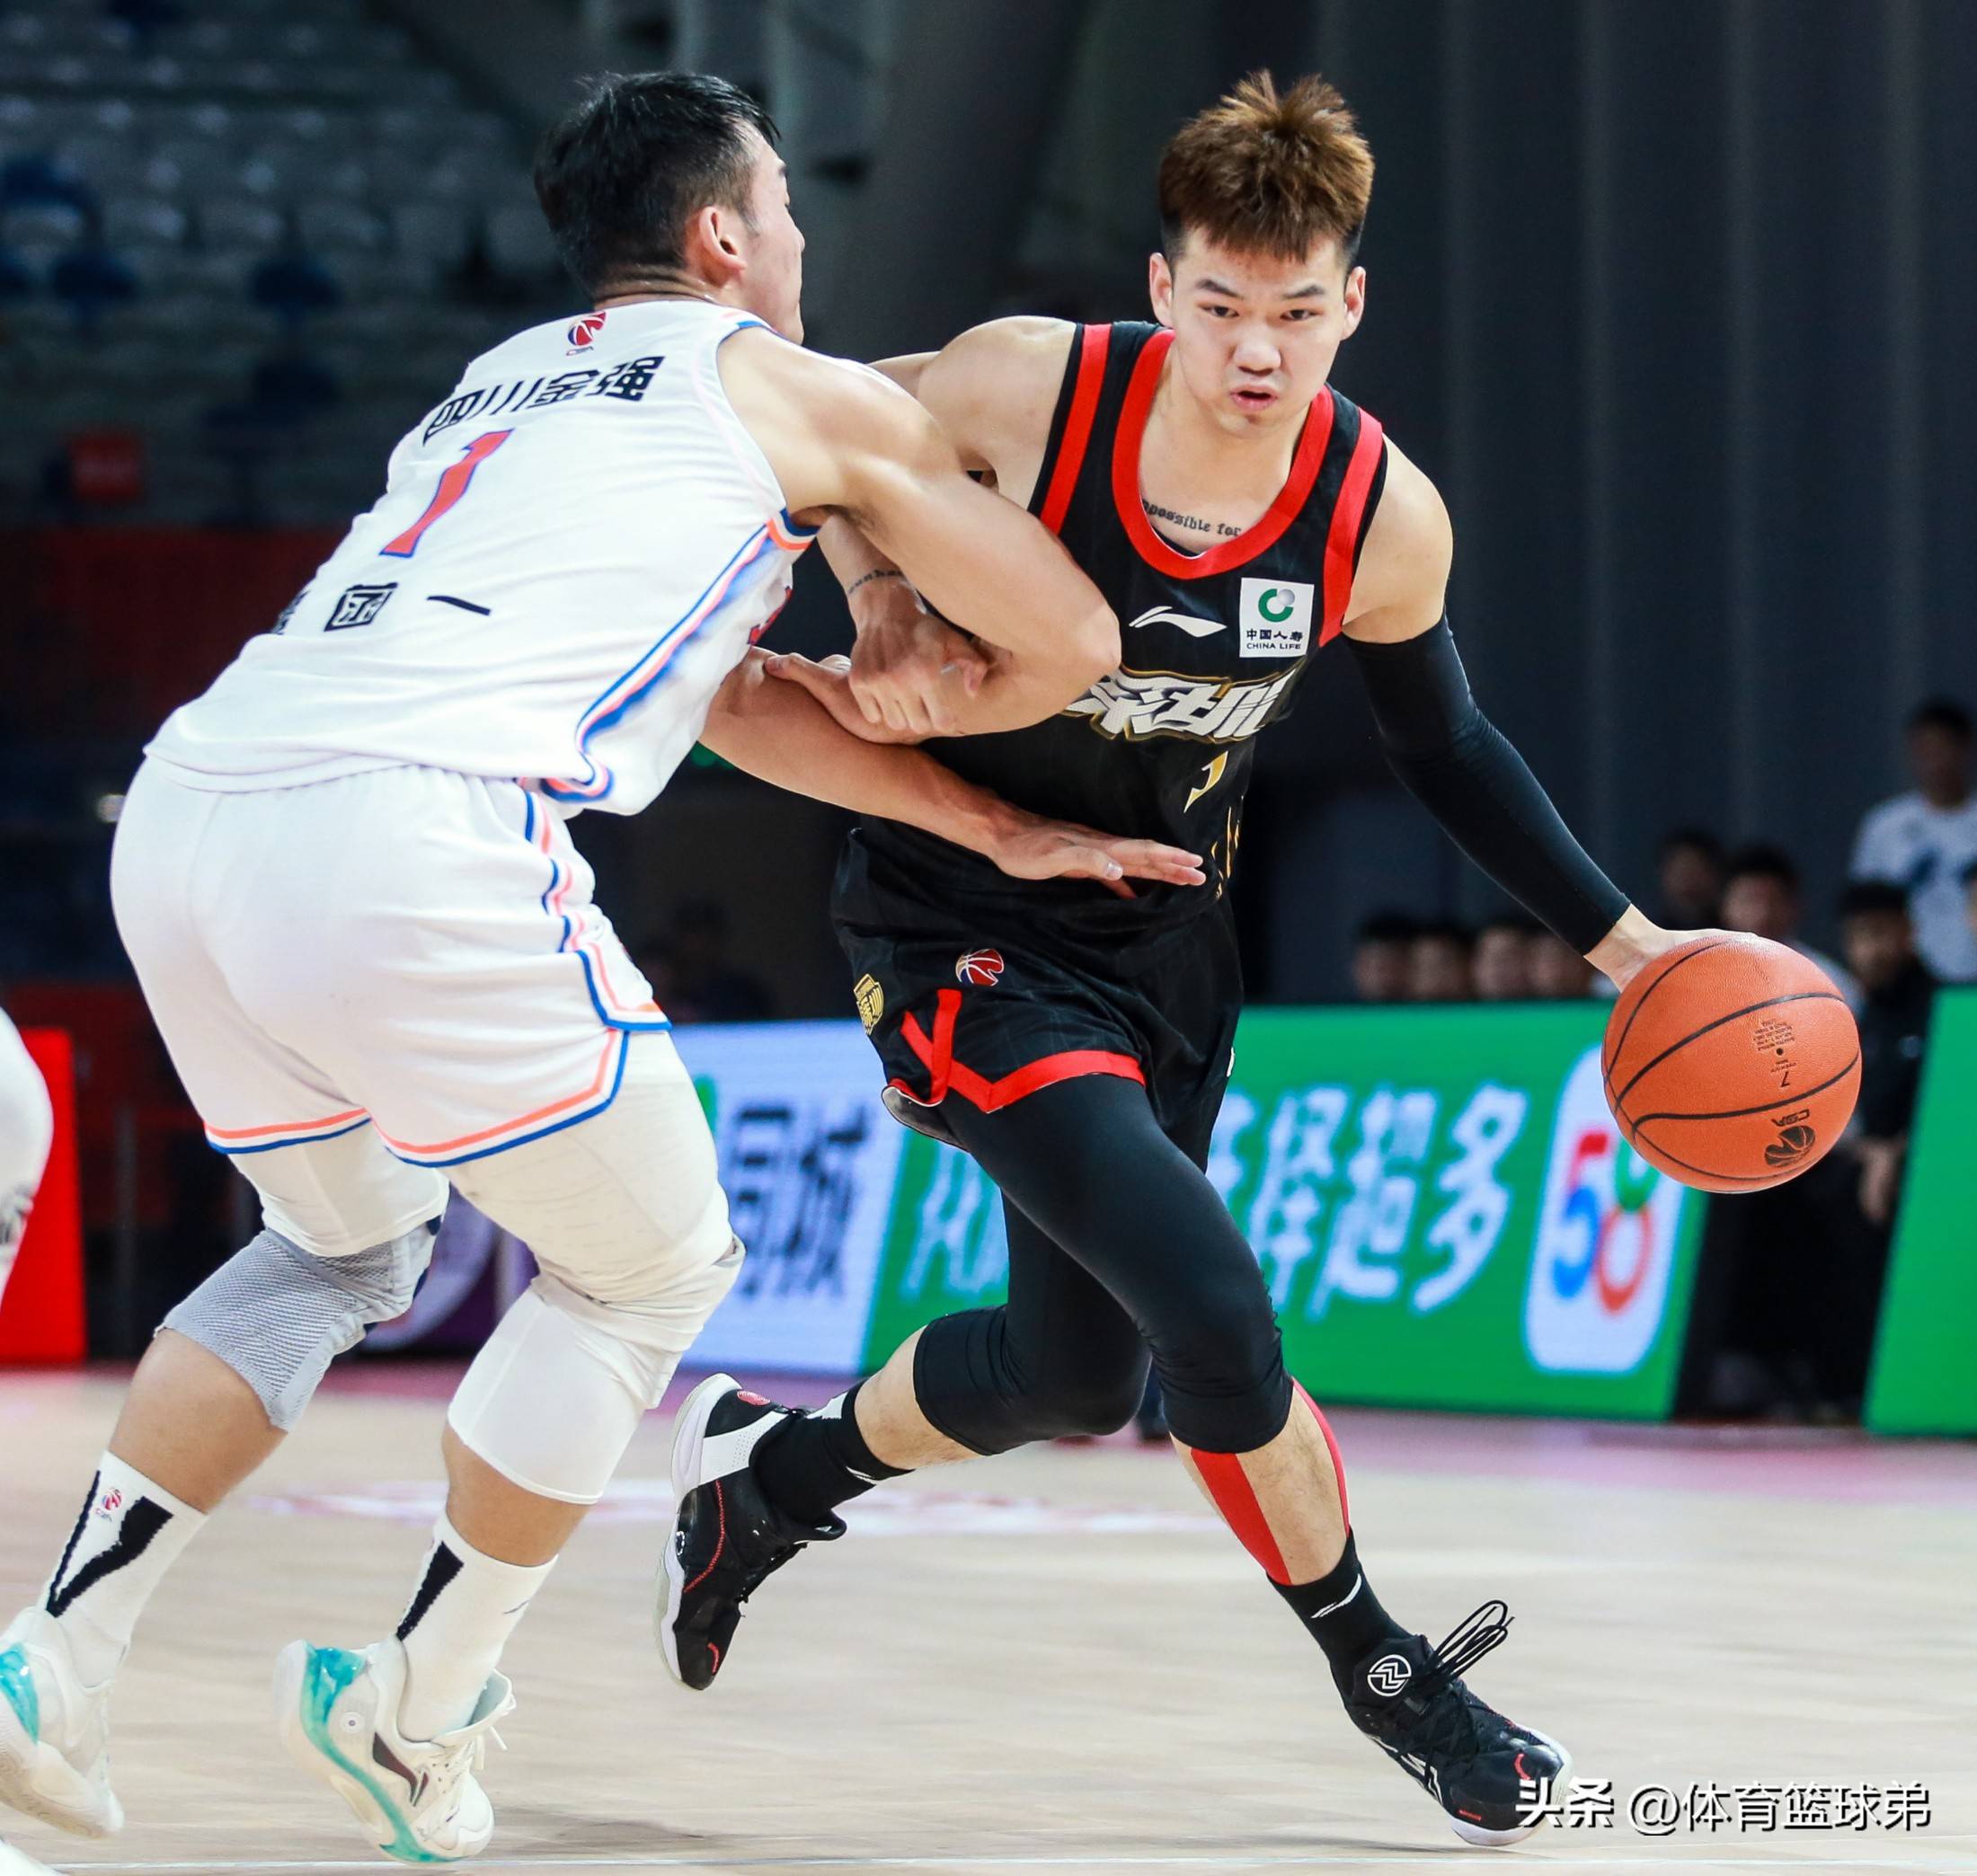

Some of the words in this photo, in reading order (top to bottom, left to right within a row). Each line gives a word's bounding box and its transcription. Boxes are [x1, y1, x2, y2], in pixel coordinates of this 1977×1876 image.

[422, 356, 665, 447] 四川金强
[379, 428, 515, 558] 1
[1246, 628, 1303, 642] 中国人寿
